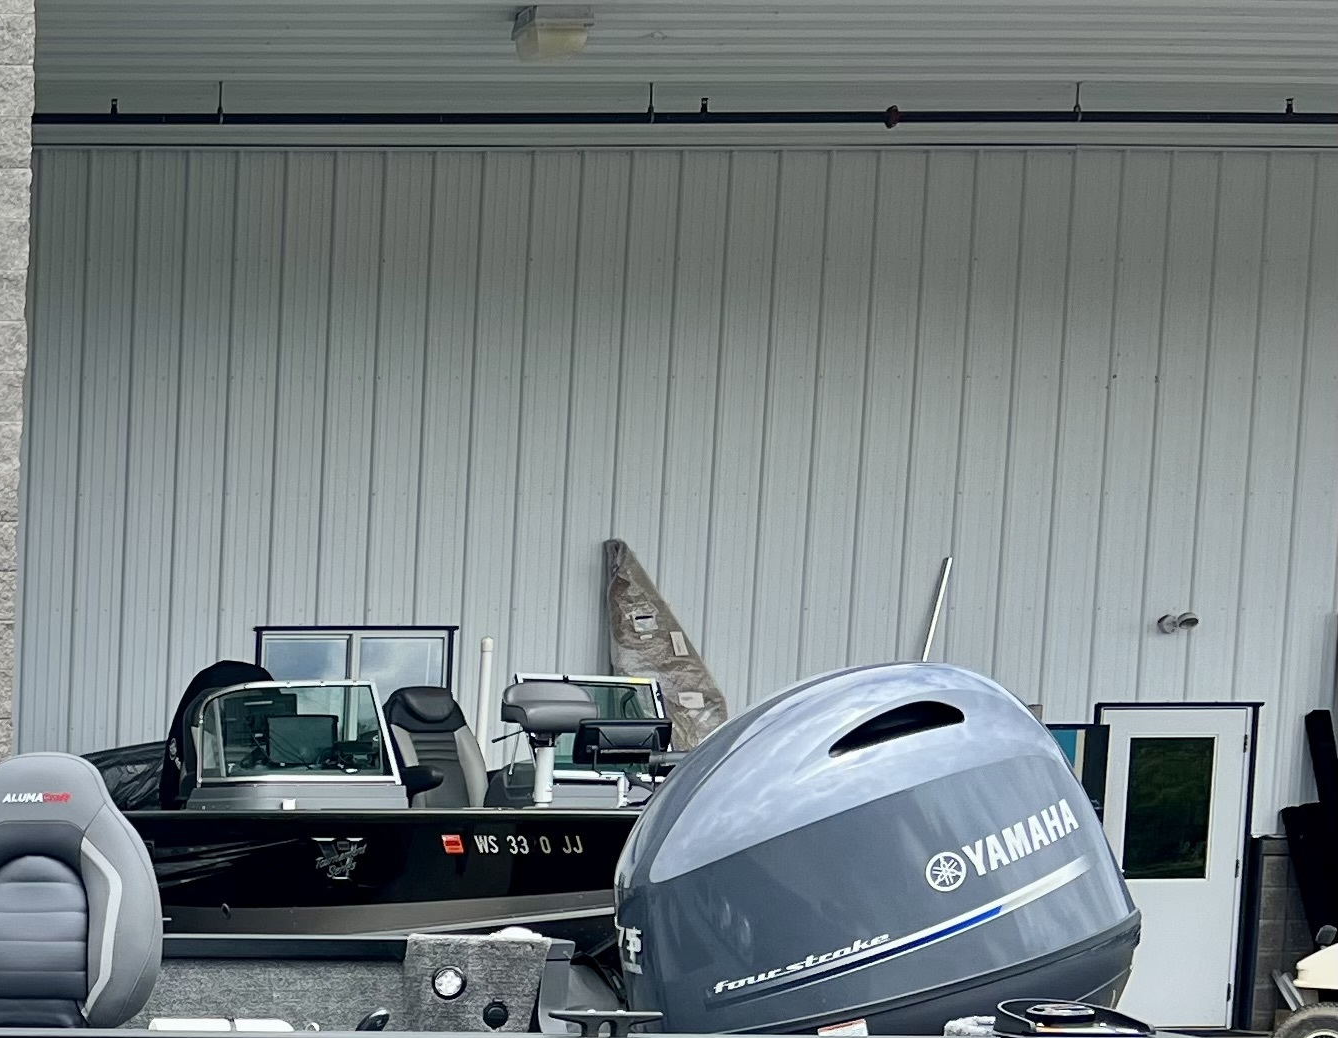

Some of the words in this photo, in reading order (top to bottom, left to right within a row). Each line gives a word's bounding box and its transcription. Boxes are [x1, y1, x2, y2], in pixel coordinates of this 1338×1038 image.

[473, 834, 499, 854] WS
[506, 835, 552, 855] 330
[562, 835, 583, 854] JJ
[961, 798, 1080, 877] YAMAHA
[713, 968, 782, 994] four
[779, 933, 890, 974] stroke
